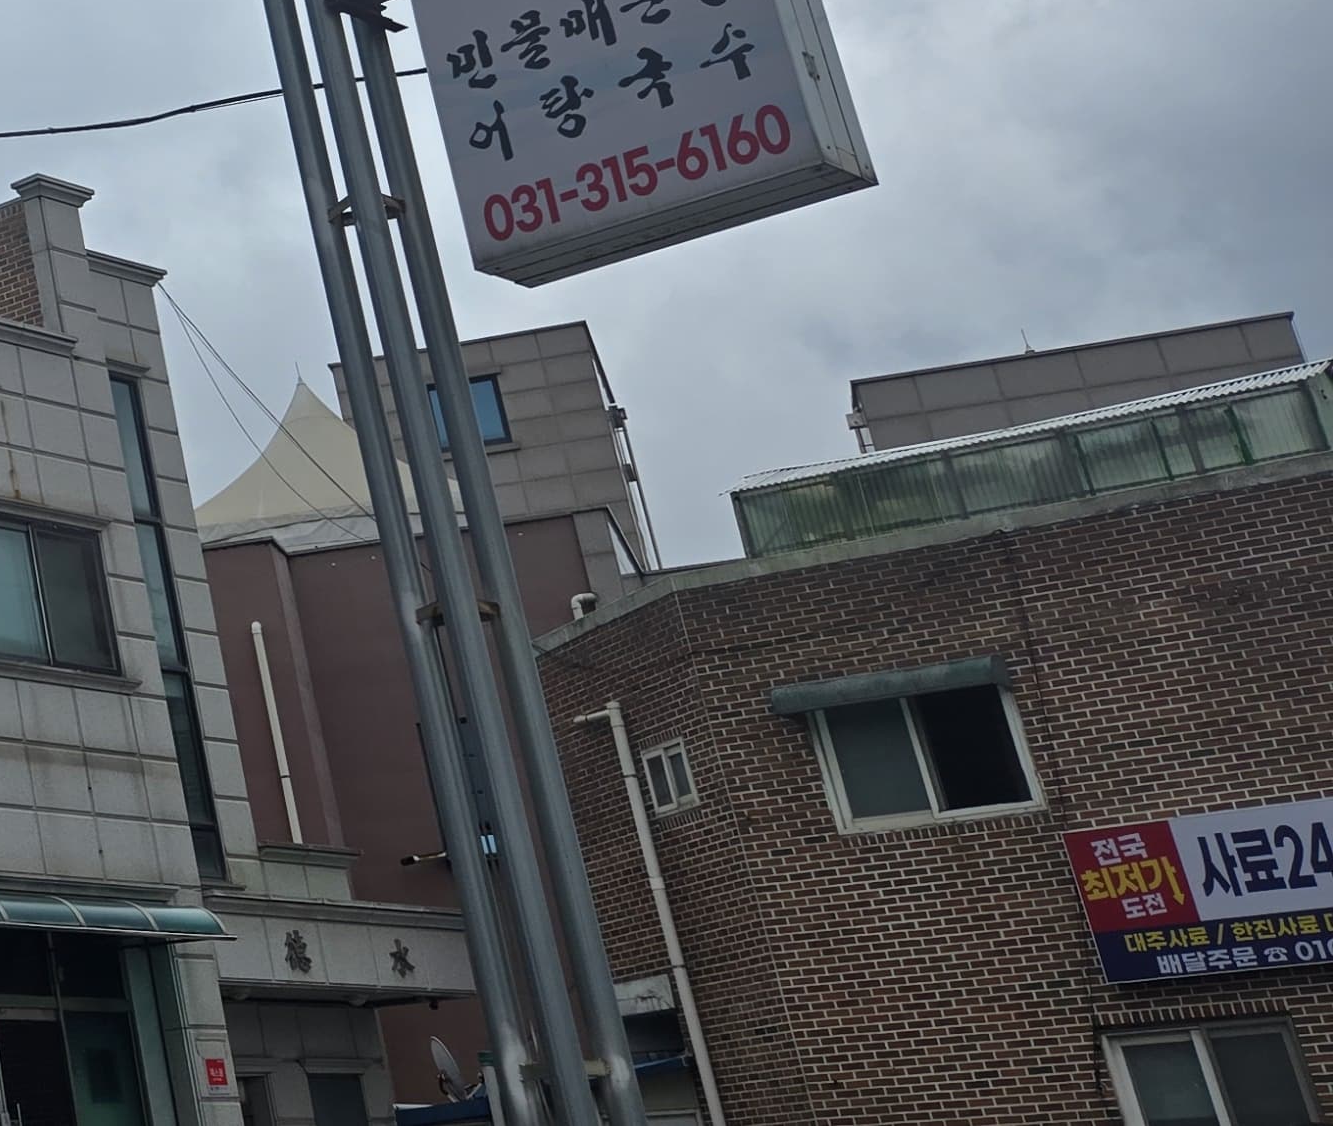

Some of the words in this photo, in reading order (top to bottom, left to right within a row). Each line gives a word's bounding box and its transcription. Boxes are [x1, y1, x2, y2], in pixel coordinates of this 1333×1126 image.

[469, 22, 755, 161] 어탕국수
[483, 104, 791, 242] 031-315-6160
[1090, 832, 1148, 866] 전국
[1080, 855, 1177, 902] 최저가
[1122, 894, 1168, 919] 도전
[1124, 925, 1210, 953] 대주사료
[1231, 915, 1322, 943] 한진사료
[1156, 944, 1258, 975] 배달주문
